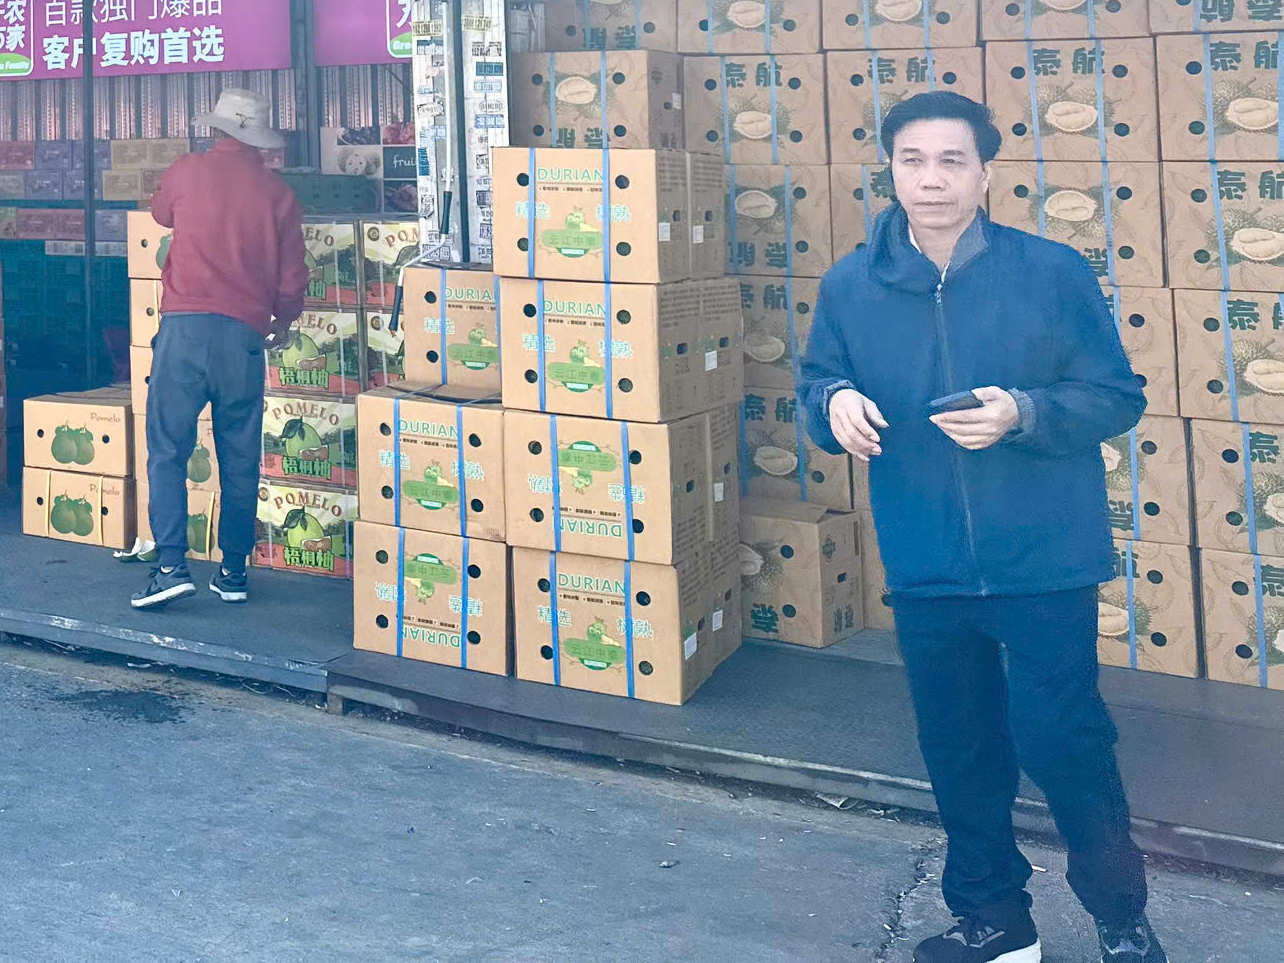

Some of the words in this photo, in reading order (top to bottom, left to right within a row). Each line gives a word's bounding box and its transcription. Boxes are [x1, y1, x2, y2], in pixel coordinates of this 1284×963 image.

[42, 26, 224, 69] 客户复购首选
[1033, 47, 1104, 77] 泰航
[393, 154, 417, 170] frui
[537, 168, 604, 182] DURIAN
[446, 287, 494, 301] DURIA
[543, 300, 606, 315] DURIAN
[90, 413, 121, 423] Pomelo
[272, 401, 340, 426] POMELO
[398, 420, 458, 437] DURIAN
[273, 491, 342, 517] POMELO
[558, 573, 625, 595] DURIAN
[402, 626, 460, 648] DURIAN
